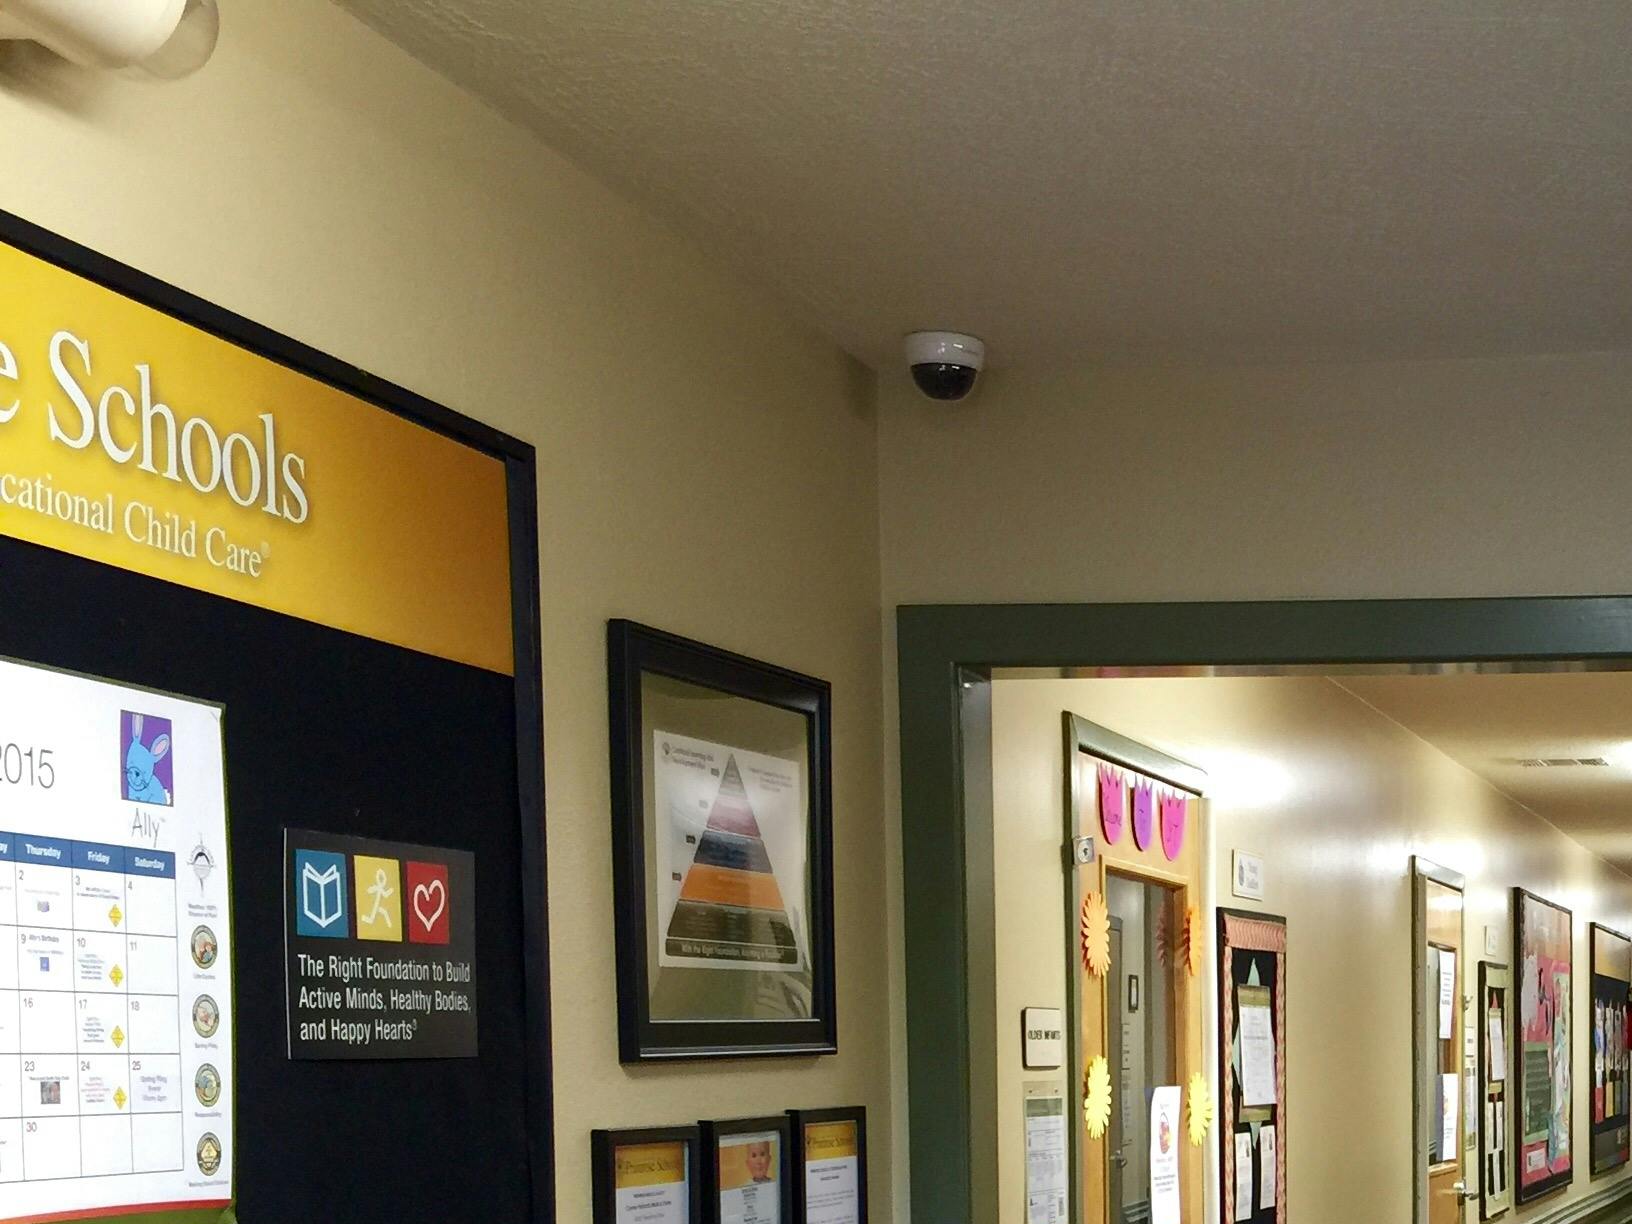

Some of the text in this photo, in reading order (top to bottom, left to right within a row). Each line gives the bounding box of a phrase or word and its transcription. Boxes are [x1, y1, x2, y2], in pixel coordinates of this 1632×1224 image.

[48, 331, 308, 524] Schools
[124, 501, 197, 558] Child
[0, 743, 55, 788] 015
[25, 843, 62, 860] Thursday
[87, 851, 110, 865] Friday
[134, 857, 165, 871] Saturday
[19, 870, 24, 880] 2
[75, 876, 81, 886] 3
[127, 881, 133, 890] 4
[21, 934, 26, 944] 9
[77, 938, 86, 947] 10
[130, 942, 137, 950] 11
[298, 954, 471, 983] The Right Foundation to Build
[24, 998, 33, 1008] 16
[79, 1000, 88, 1010] 17
[299, 986, 472, 1015] Active Minds, Healthy Bodies,
[131, 1001, 140, 1011] 18
[300, 1019, 326, 1041] and
[331, 1018, 371, 1045] Happy
[25, 1061, 35, 1072] 23
[81, 1062, 90, 1071] 24
[132, 1061, 141, 1071] 25
[27, 1122, 37, 1132] 30
